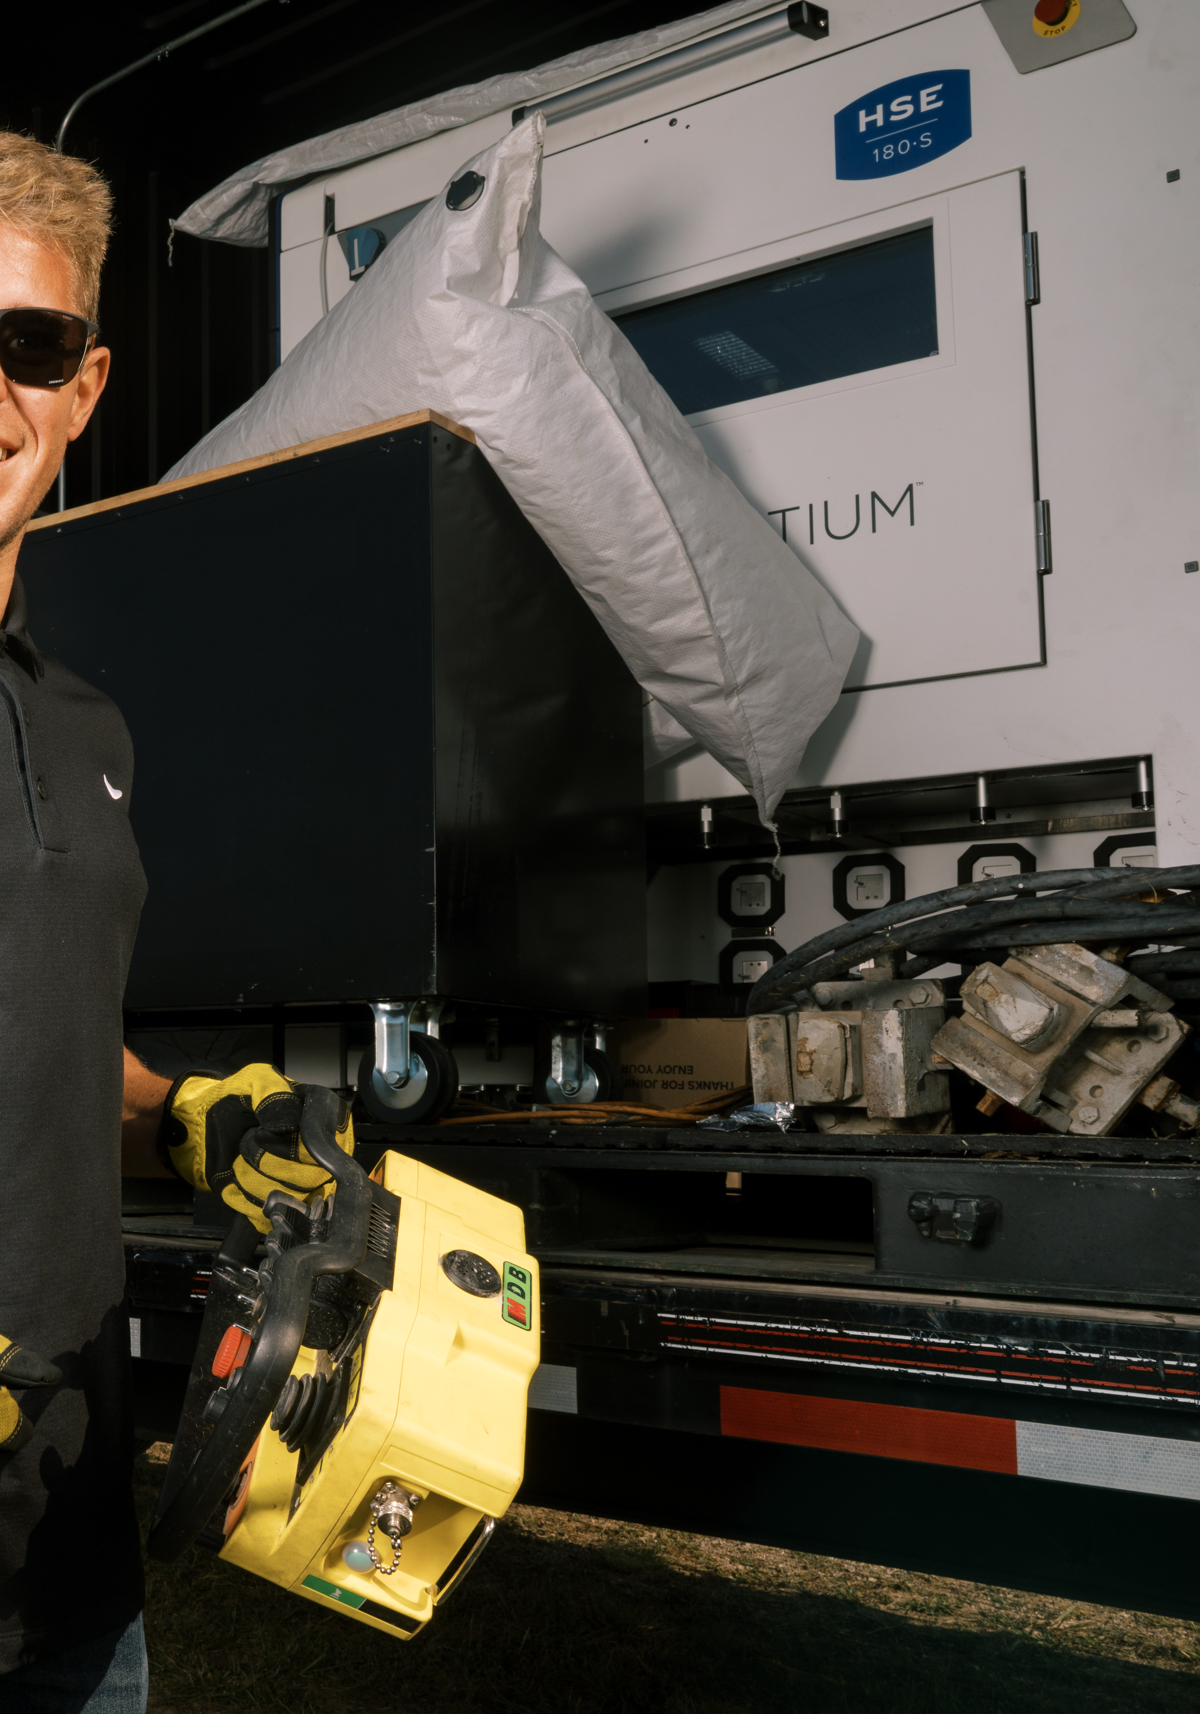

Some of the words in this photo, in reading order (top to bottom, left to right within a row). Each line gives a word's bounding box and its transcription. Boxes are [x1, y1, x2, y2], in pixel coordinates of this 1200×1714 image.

[1043, 25, 1066, 36] STOP
[858, 83, 944, 133] HSE
[621, 1064, 653, 1074] YOUR
[656, 1065, 694, 1075] ENJOY
[661, 1079, 685, 1090] FOR
[688, 1080, 734, 1091] THANKS
[506, 1266, 527, 1327] MDB
